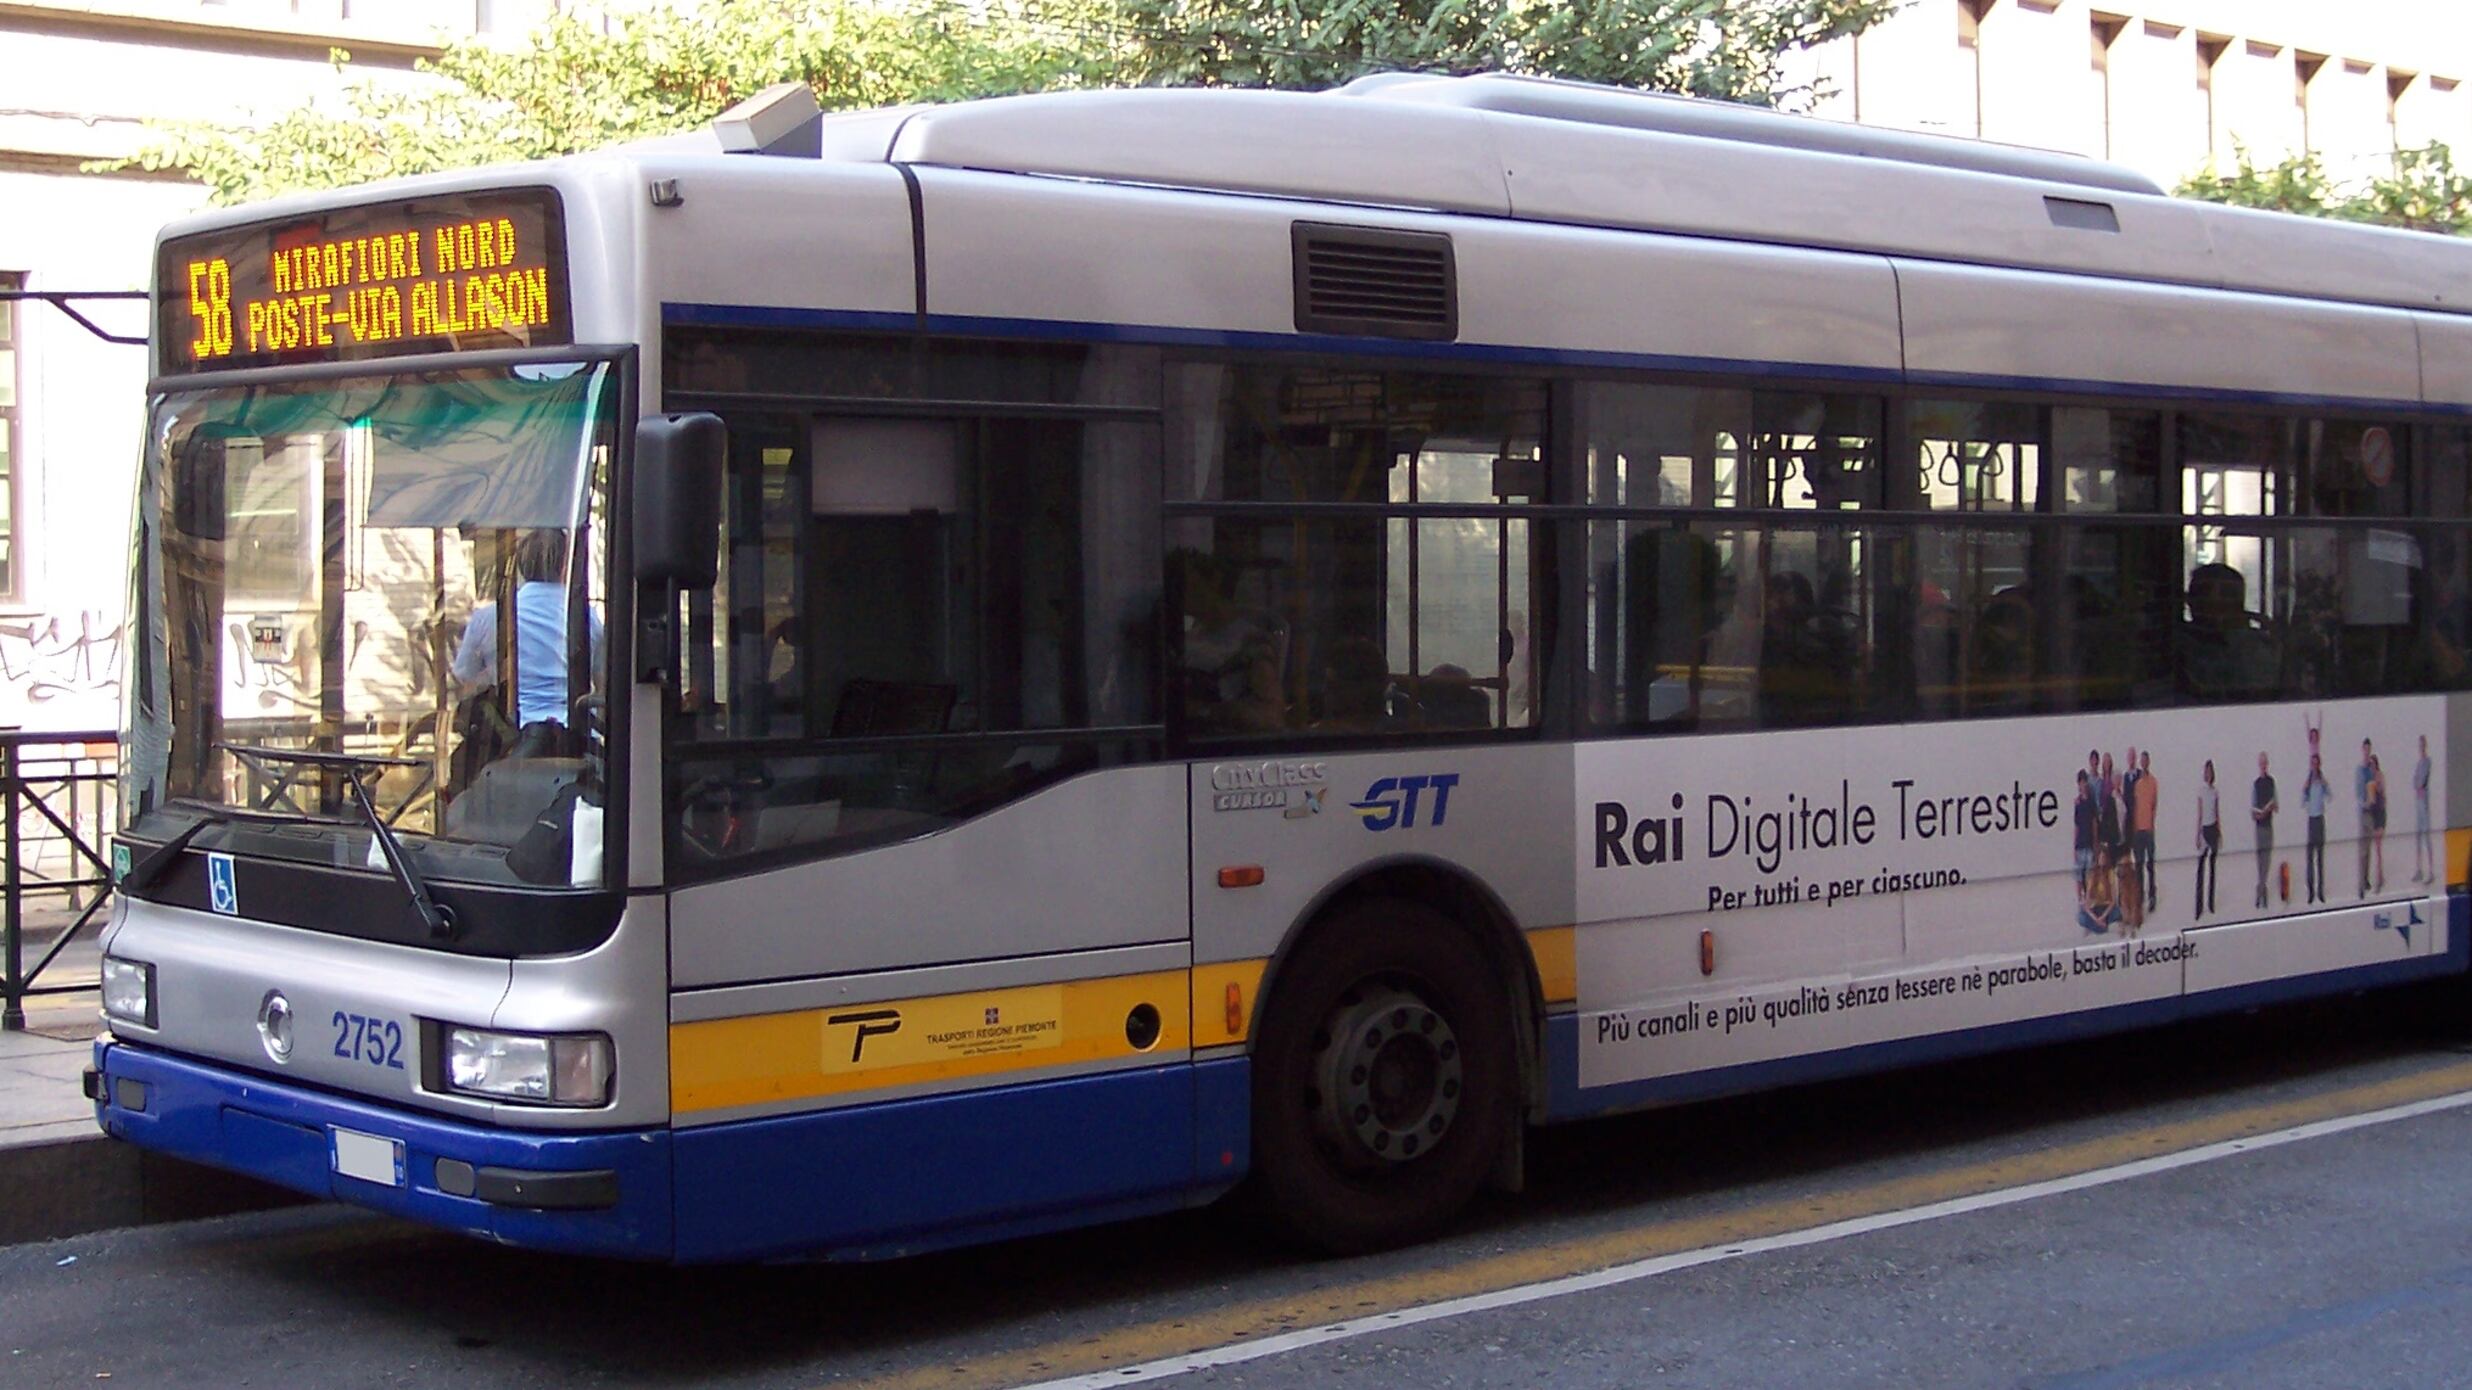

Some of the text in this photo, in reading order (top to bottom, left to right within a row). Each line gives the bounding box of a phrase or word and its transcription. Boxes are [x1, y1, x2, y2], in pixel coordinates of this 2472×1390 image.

[273, 218, 516, 293] MIRAFIORI NORD
[188, 258, 233, 358] 58
[248, 268, 550, 352] POSTE-VIA ALLASON
[1352, 773, 1459, 831] GTT
[1595, 779, 2059, 874] Rai Digitale Terrestre
[1708, 865, 1968, 912] Per tutti e per ciascuno.
[1598, 938, 2199, 1044] Più canali e più qualità senza tessere nè parabole, basta il decoder.
[332, 1011, 404, 1070] 2752
[976, 1025, 1014, 1039] REGIONE
[1015, 1019, 1057, 1033] PIEMONTE
